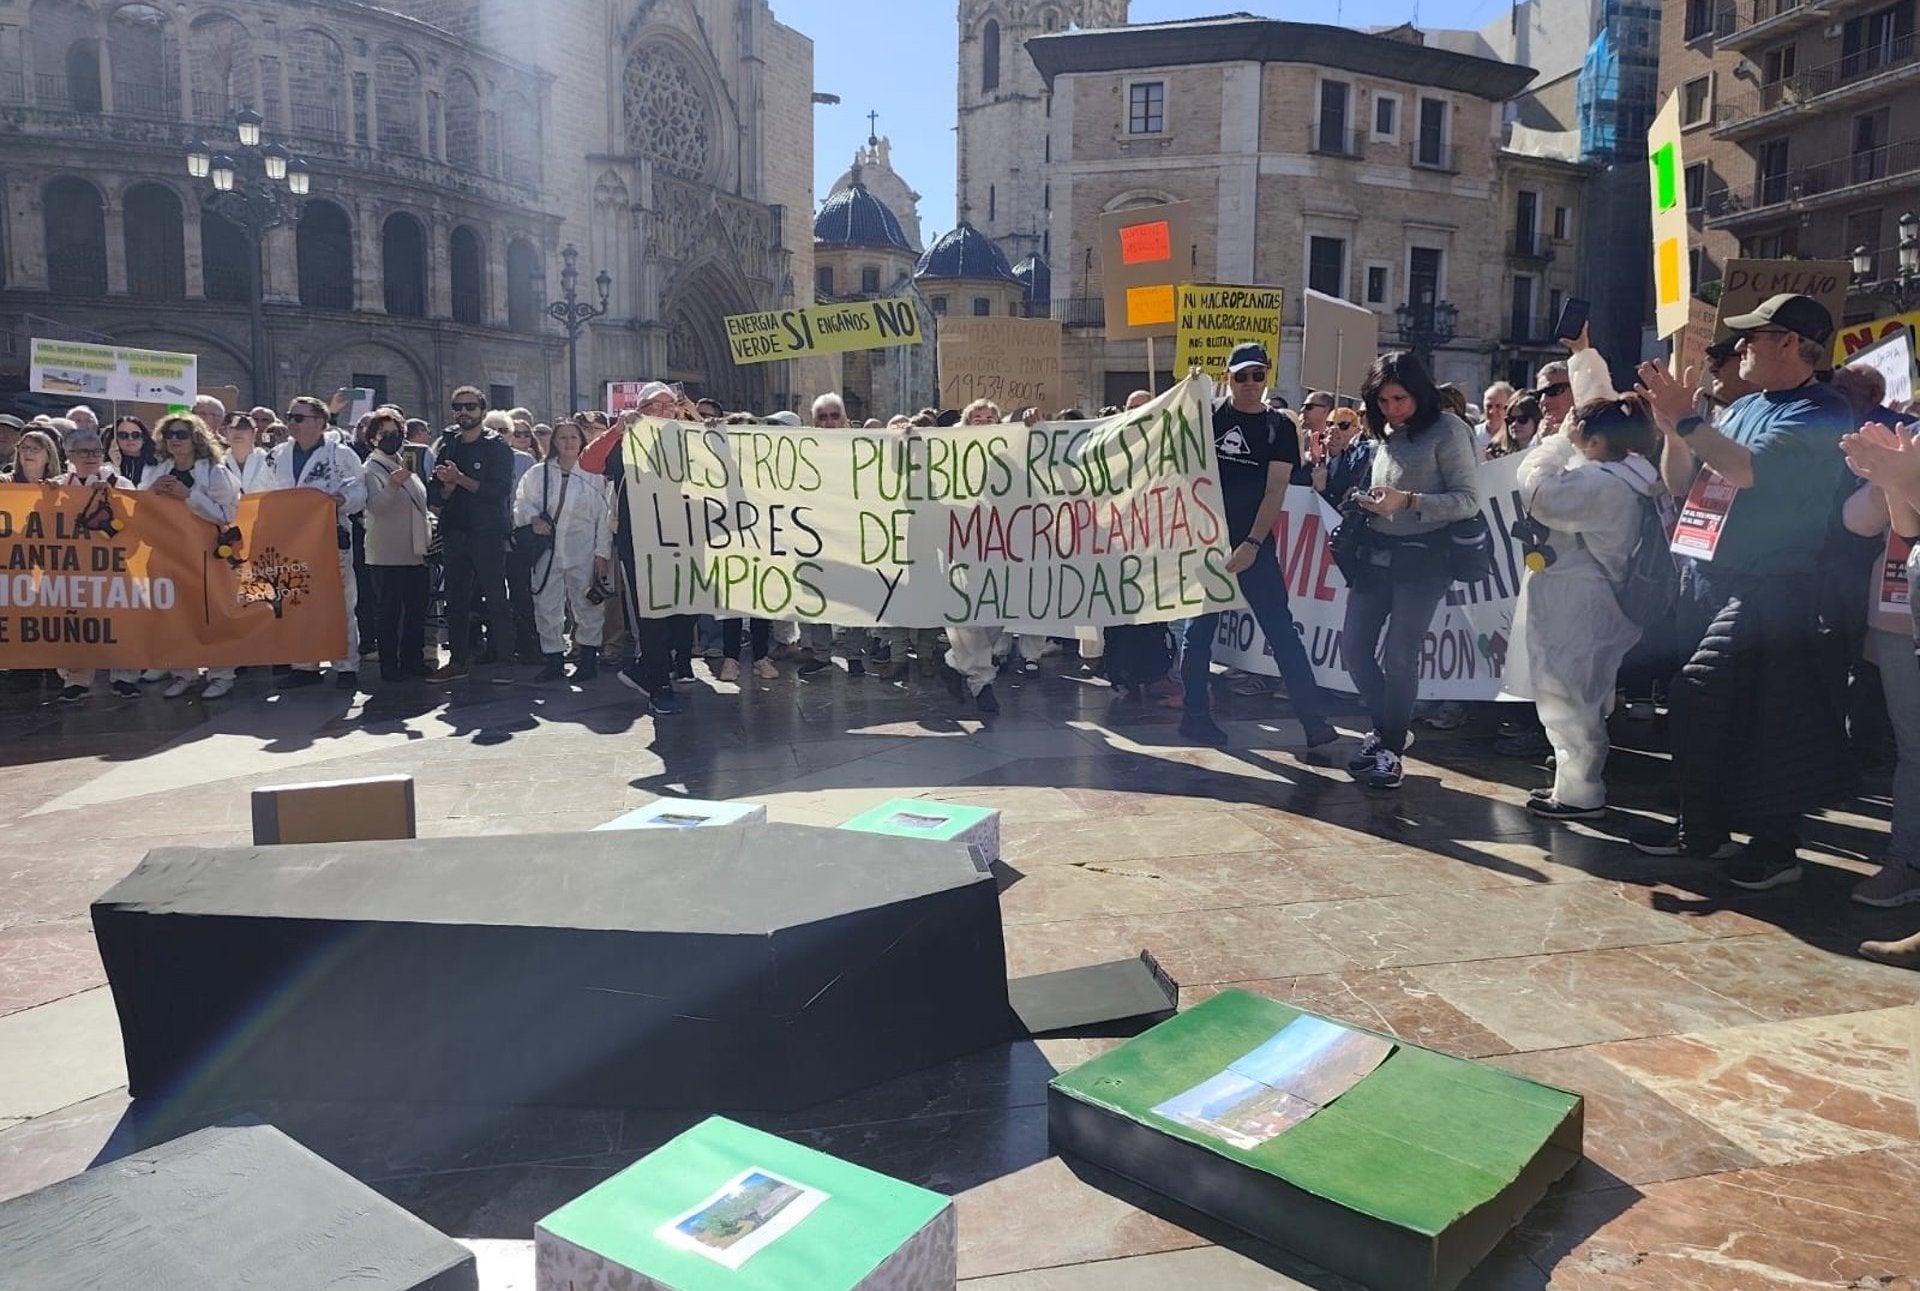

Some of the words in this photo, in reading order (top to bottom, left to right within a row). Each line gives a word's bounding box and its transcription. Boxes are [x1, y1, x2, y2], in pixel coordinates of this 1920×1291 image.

[1184, 293, 1196, 309] NI
[1201, 291, 1281, 310] MACROPLANTAS
[727, 312, 780, 336] ENERGIA
[816, 309, 870, 335] ENGAÑOS
[872, 301, 916, 339] NO
[1197, 313, 1279, 336] MACROGRANJAS
[732, 334, 783, 358] VERDE
[1188, 337, 1204, 348] NOS
[1206, 336, 1235, 348] QUITAN
[1188, 356, 1204, 366] NOS
[1206, 356, 1227, 367] DEJA
[627, 424, 822, 491] NUESTROS
[851, 436, 1012, 501] PUEBLOS
[1026, 398, 1207, 498] RESUCITAN
[25, 511, 45, 539] A
[859, 509, 916, 565] DE
[948, 477, 1219, 563] MACROPLANTAS
[0, 543, 80, 571] ANTA
[91, 546, 127, 573] DE
[875, 567, 904, 623] Y
[944, 547, 1236, 624] SALUDABLES
[20, 609, 118, 644] BUÑOL
[1217, 610, 1255, 652] ERO
[1420, 613, 1476, 681] RÓN
